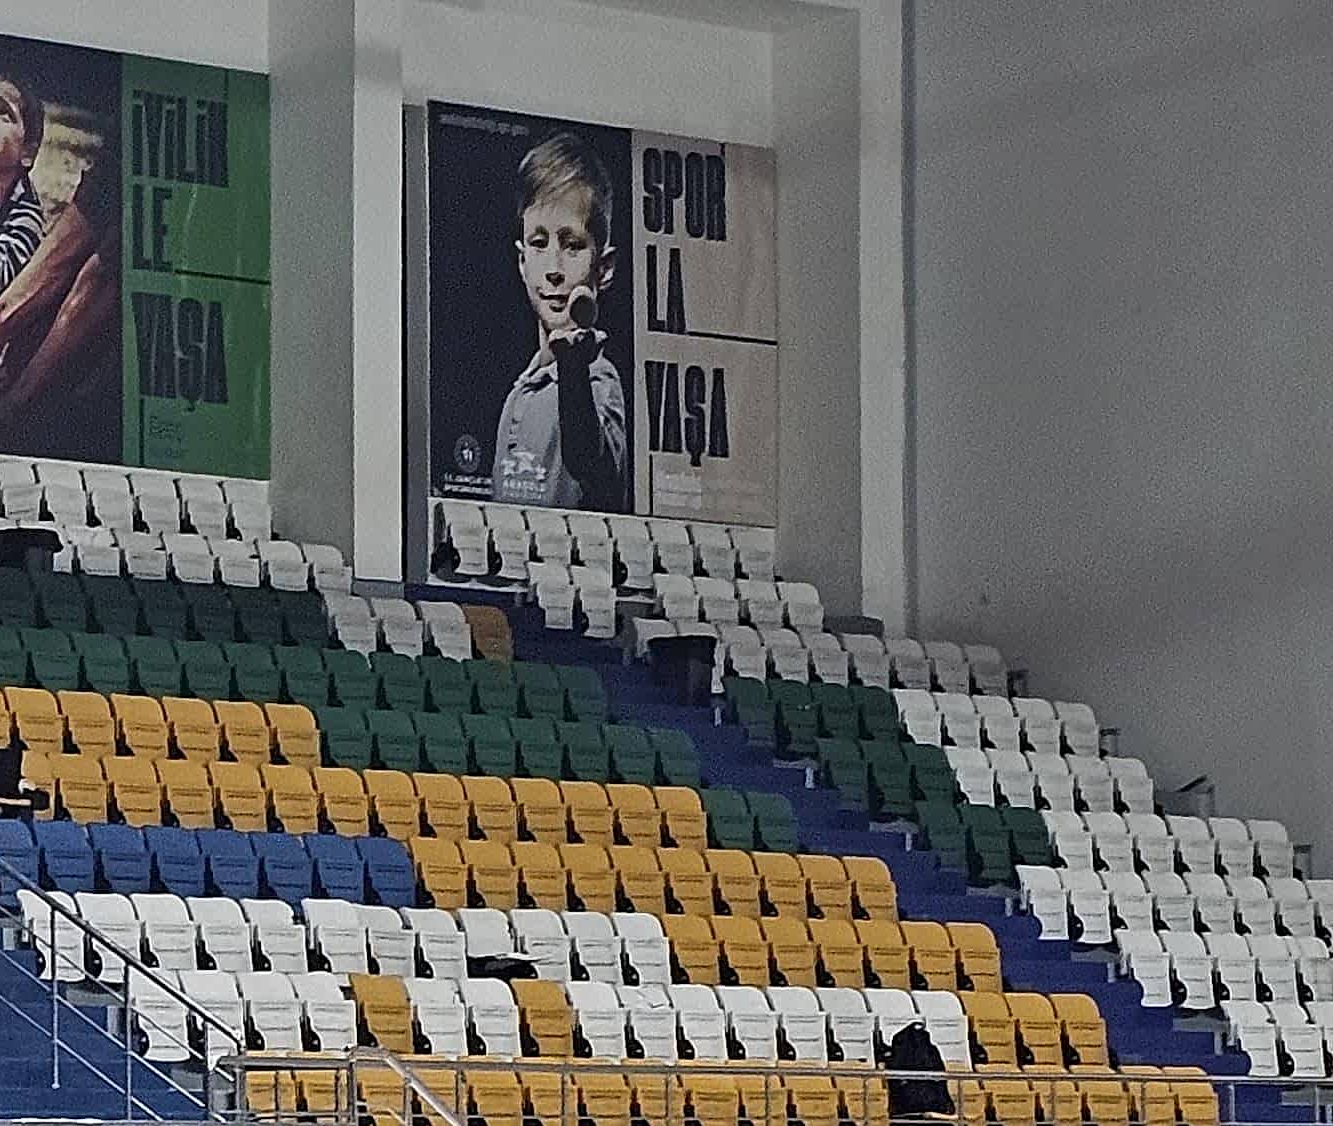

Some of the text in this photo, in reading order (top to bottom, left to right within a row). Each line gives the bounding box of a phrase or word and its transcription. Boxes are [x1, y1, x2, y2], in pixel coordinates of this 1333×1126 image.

[642, 147, 727, 241] SPOR
[645, 244, 686, 335] LA
[644, 360, 730, 467] YAŞA
